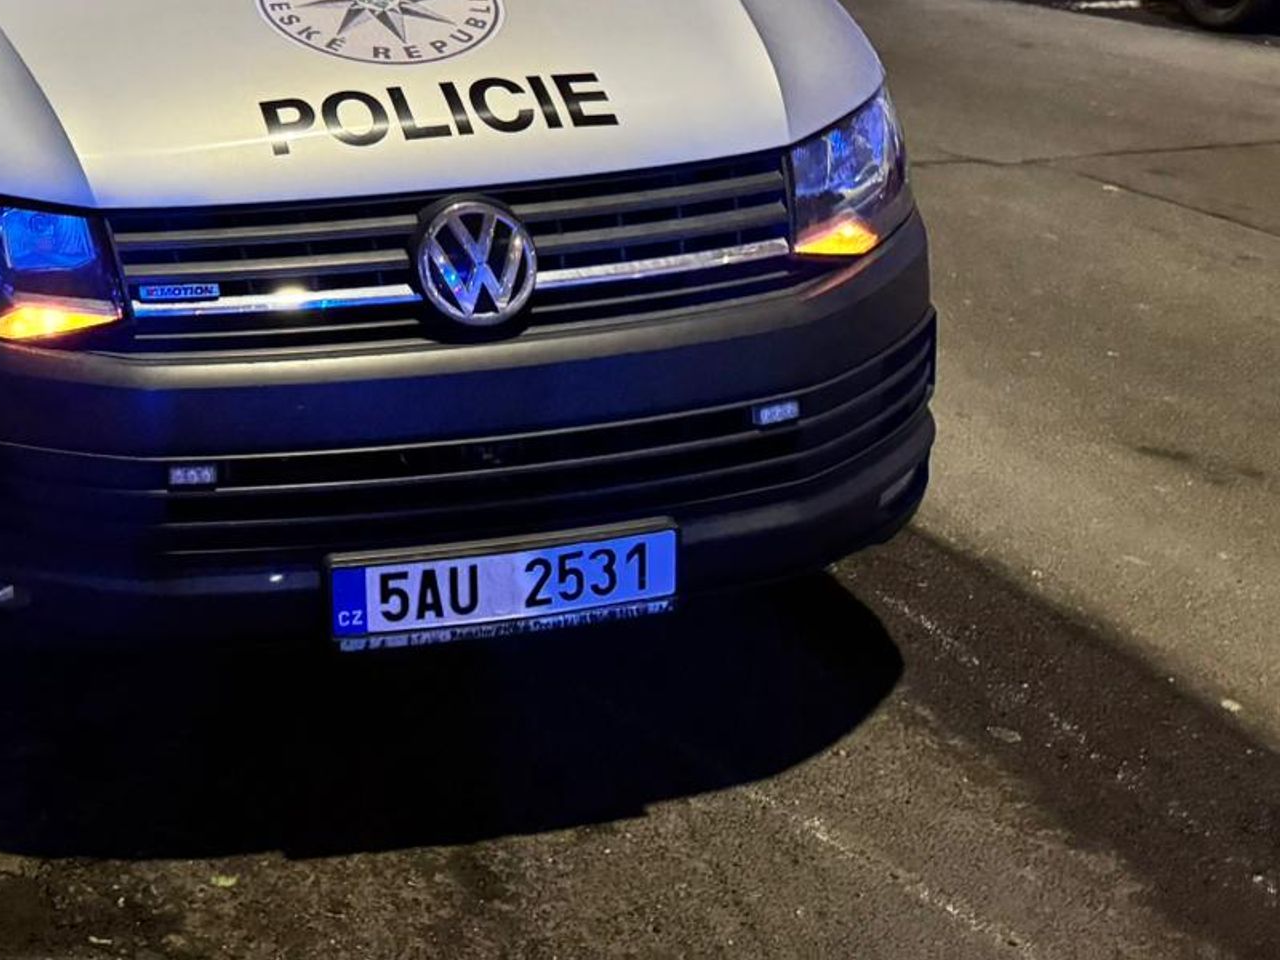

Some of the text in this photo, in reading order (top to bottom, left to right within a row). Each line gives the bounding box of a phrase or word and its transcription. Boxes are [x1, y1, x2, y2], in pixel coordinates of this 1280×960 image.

[258, 71, 620, 156] POLICIE
[337, 610, 364, 627] CZ
[378, 542, 648, 623] 5AU 2531
